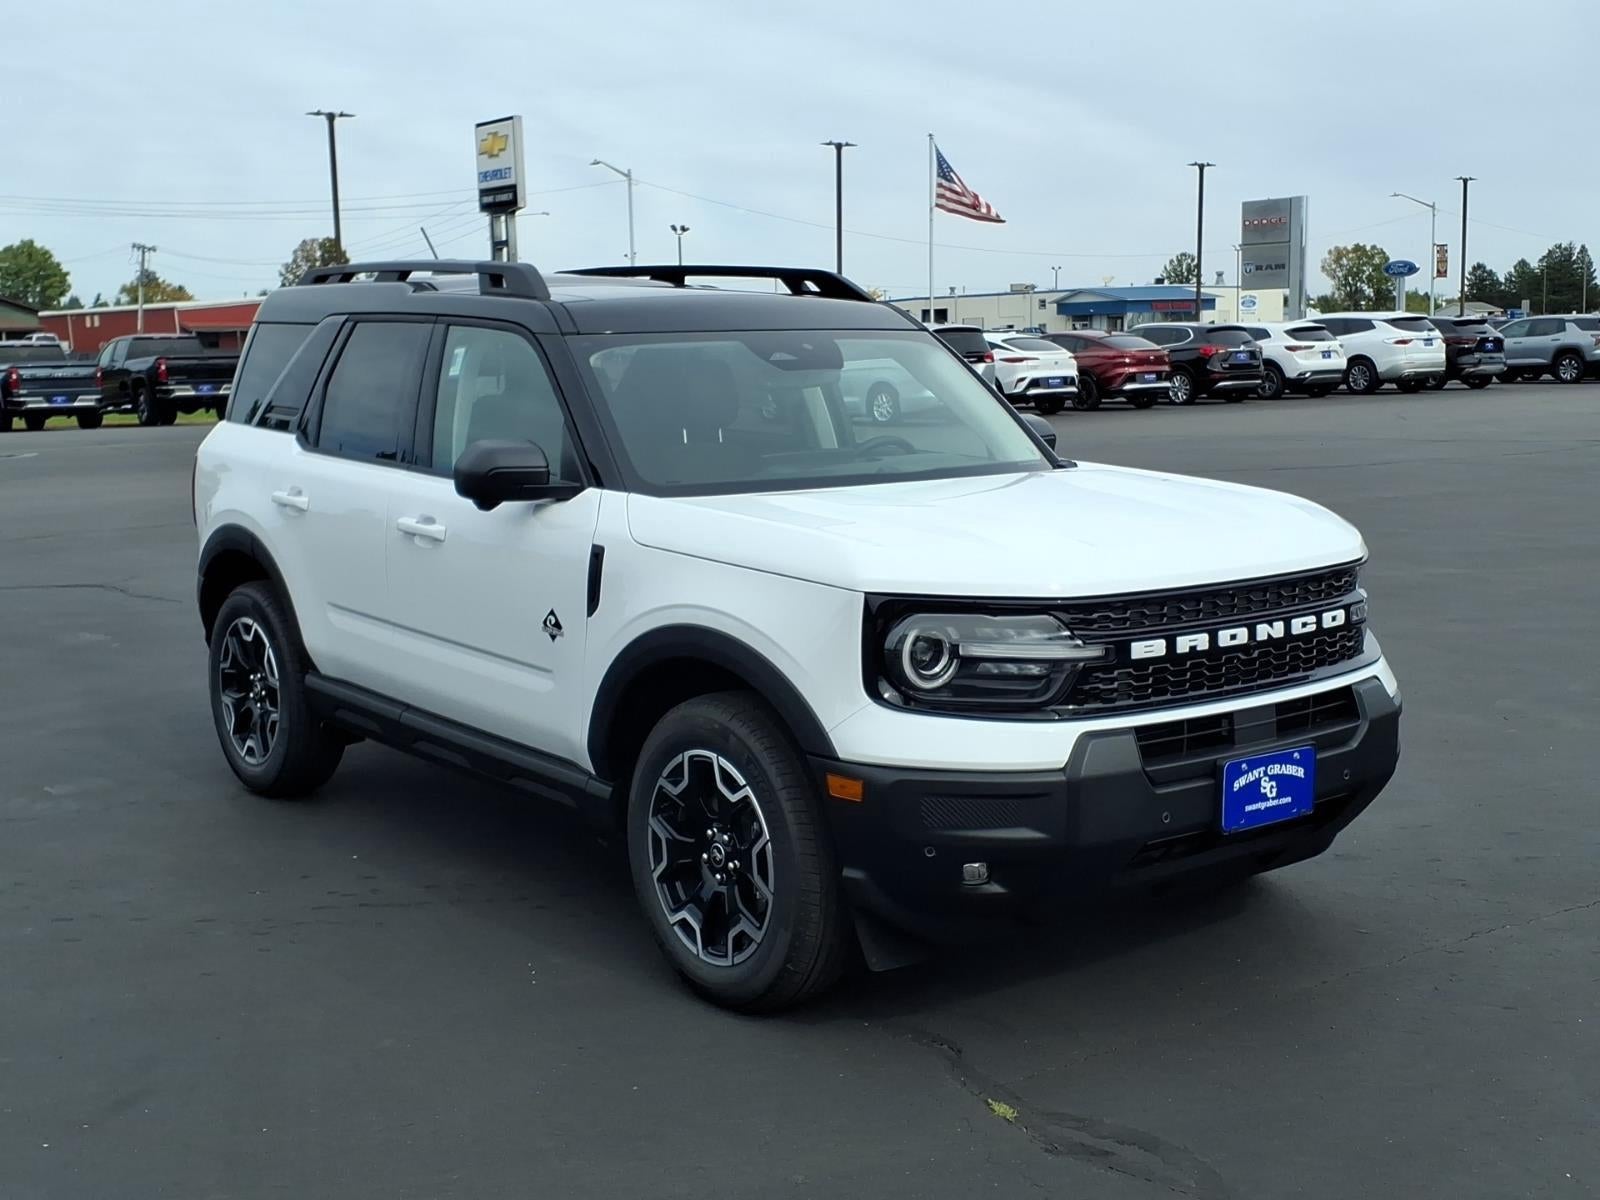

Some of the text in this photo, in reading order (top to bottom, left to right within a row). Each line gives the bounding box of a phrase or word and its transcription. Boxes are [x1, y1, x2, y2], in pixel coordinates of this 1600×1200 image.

[479, 167, 512, 183] CHEVROLET
[1243, 217, 1287, 227] DODGE
[1255, 263, 1286, 272] RAM
[1388, 263, 1410, 274] Ford
[1130, 608, 1345, 660] BRONCO
[1233, 764, 1305, 792] SWANT GRABER
[1260, 776, 1278, 798] SG
[1245, 796, 1292, 813] swantgraber.com
